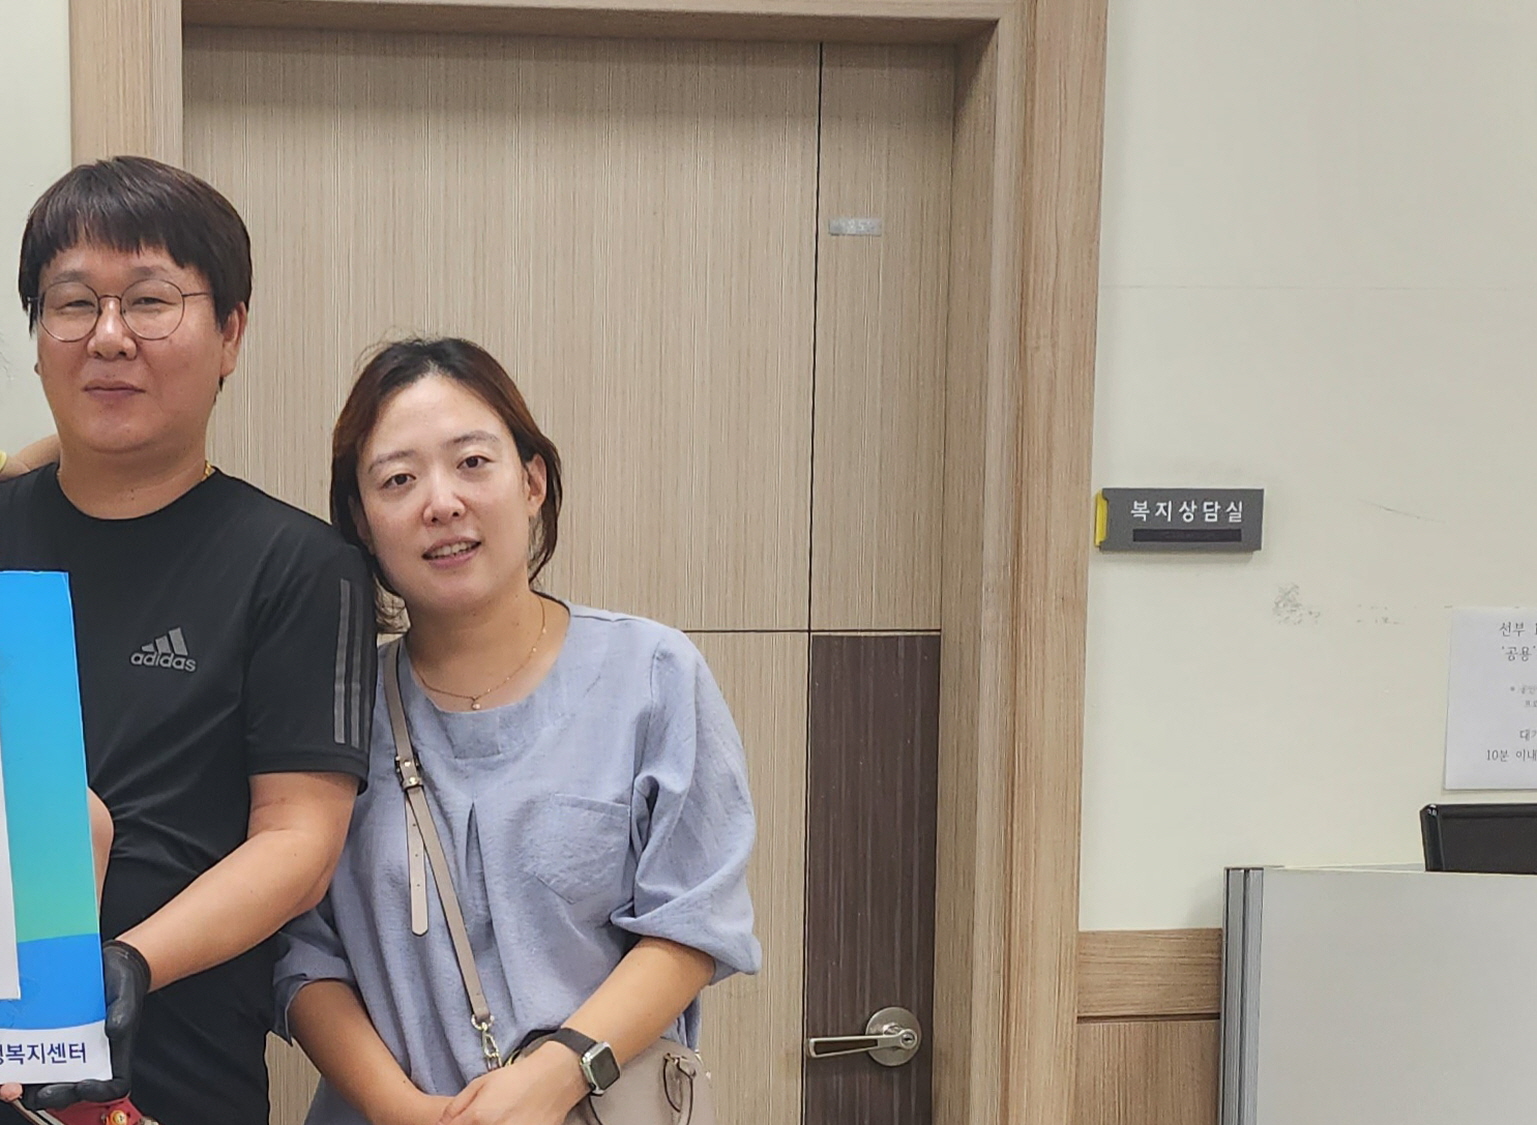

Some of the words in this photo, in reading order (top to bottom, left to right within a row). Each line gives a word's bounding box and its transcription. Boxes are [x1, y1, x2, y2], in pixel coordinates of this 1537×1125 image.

[1130, 500, 1244, 523] 복지상담실
[1499, 621, 1526, 637] 선부
[130, 651, 197, 673] adidas
